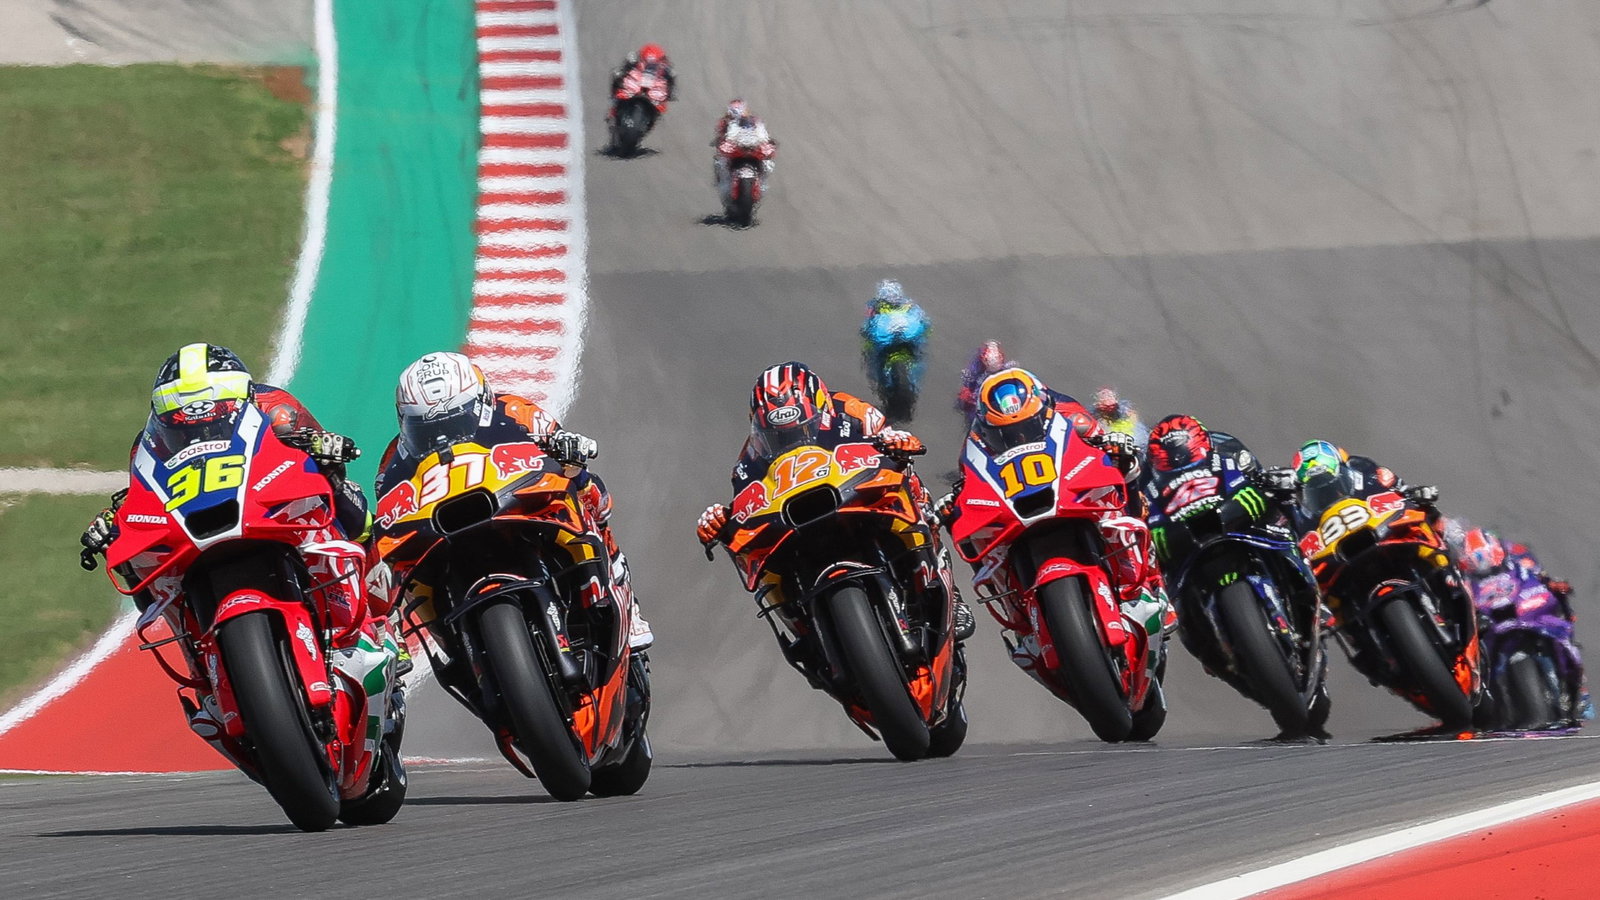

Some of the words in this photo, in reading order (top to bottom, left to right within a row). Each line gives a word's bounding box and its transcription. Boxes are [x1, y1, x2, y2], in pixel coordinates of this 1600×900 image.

[416, 362, 447, 377] FONT
[771, 408, 796, 421] Arai
[179, 441, 229, 460] Castrol
[253, 460, 296, 492] HONDA
[420, 452, 490, 508] 37
[772, 450, 832, 500] 12
[999, 453, 1058, 499] 10
[1064, 456, 1096, 481] HONDA
[165, 454, 246, 513] 36
[966, 498, 1001, 508] HONDA
[125, 513, 169, 525] HONDA
[1321, 504, 1372, 545] 33
